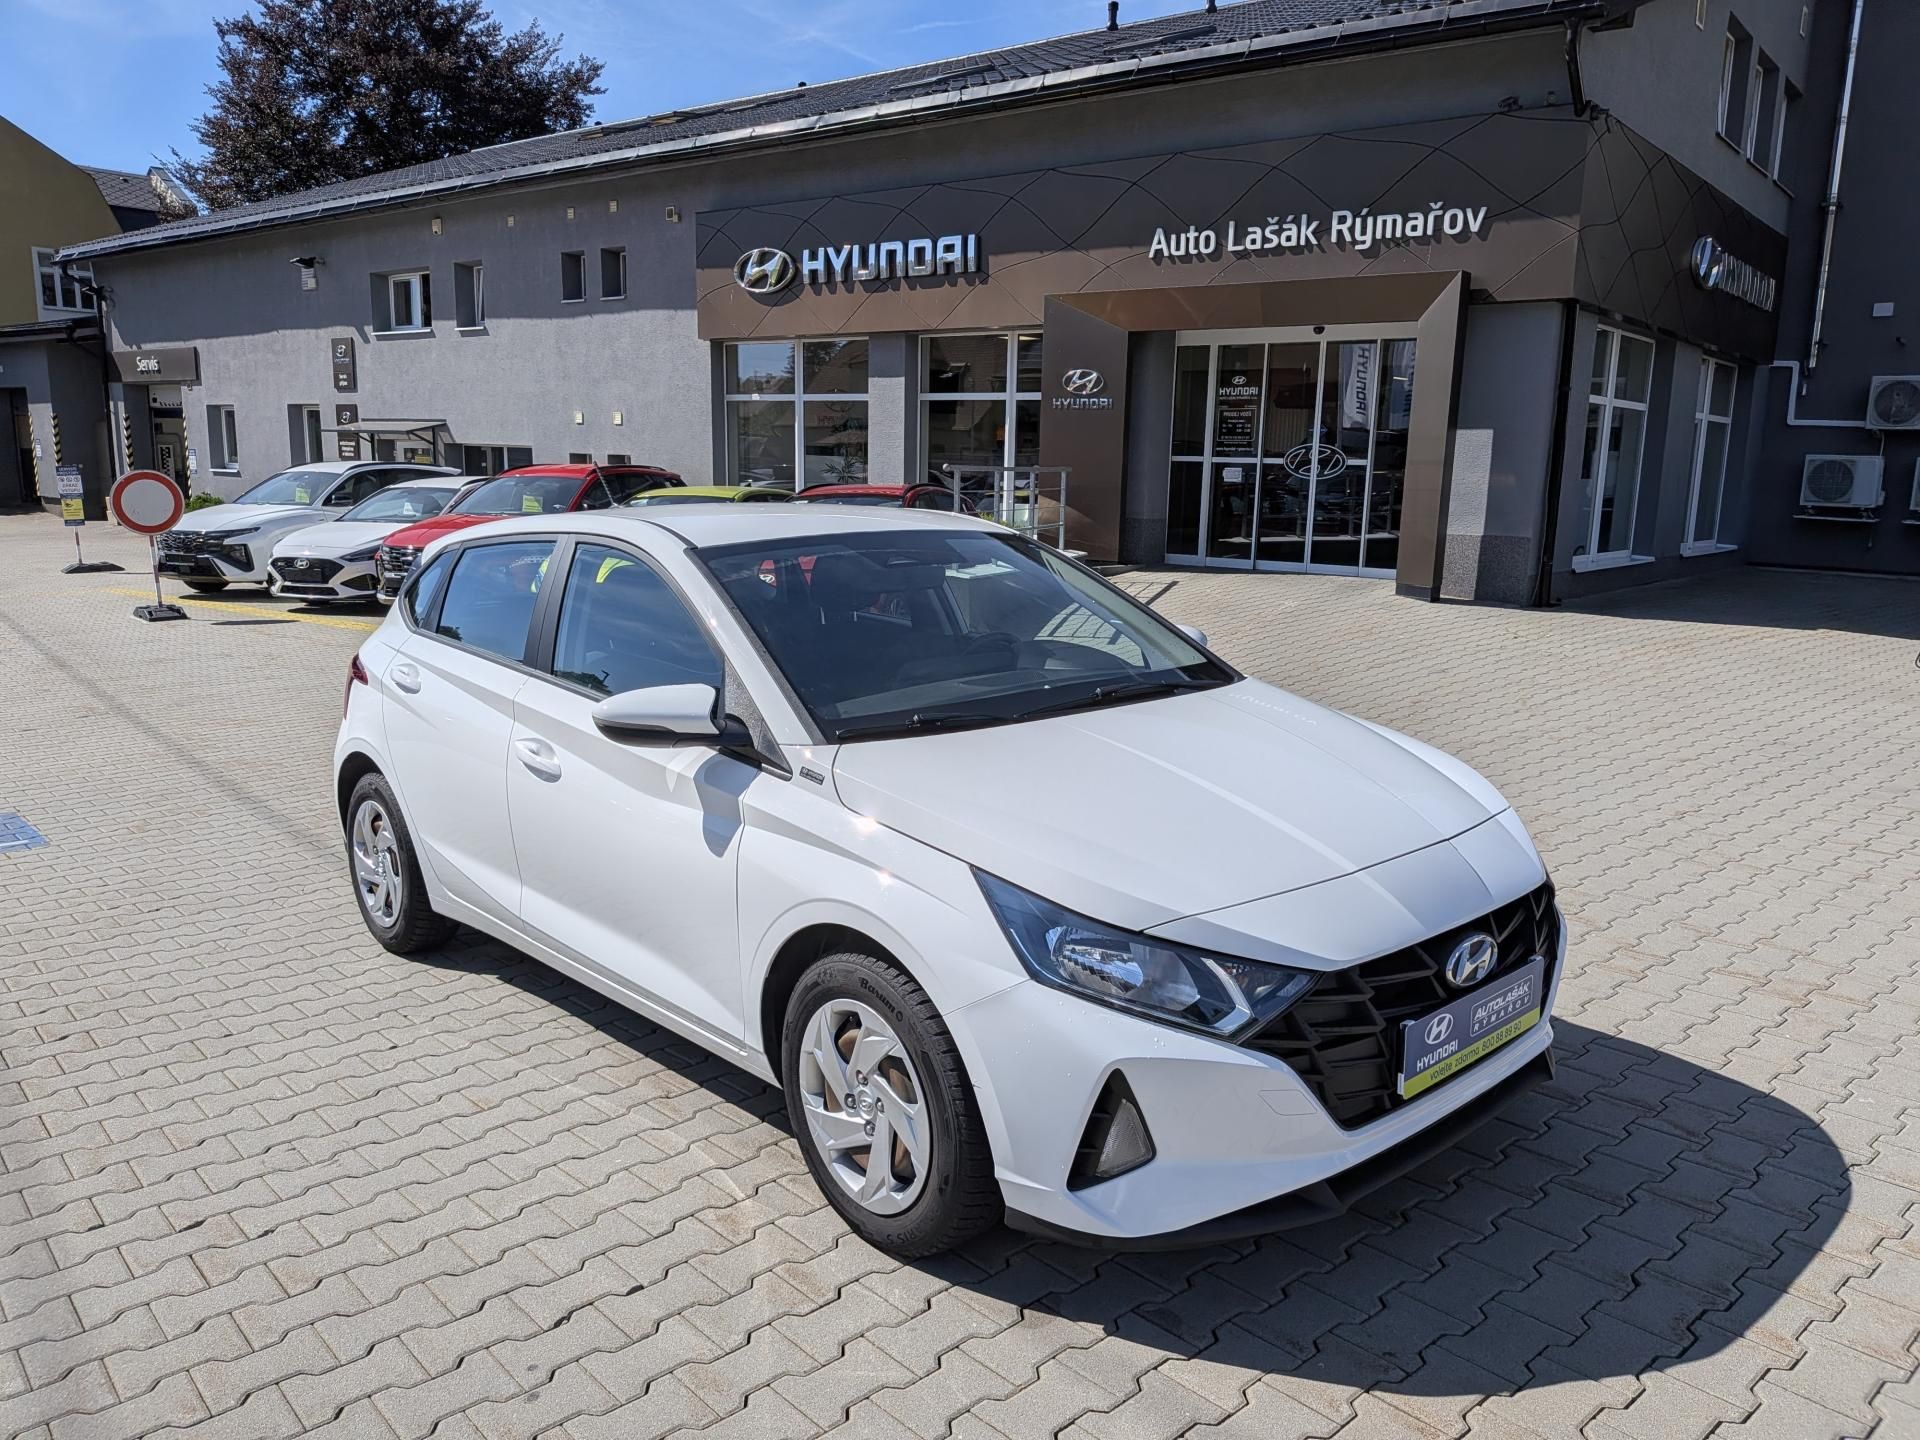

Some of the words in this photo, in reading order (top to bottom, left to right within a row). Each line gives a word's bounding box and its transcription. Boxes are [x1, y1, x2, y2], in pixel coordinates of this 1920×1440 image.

[1149, 225, 1217, 258] Auto
[1227, 213, 1320, 251] Lašák
[1331, 201, 1488, 250] Rýmařov
[802, 233, 981, 285] HYUNDAI
[136, 355, 160, 372] Servis
[1356, 345, 1371, 417] HYUNDAI
[1052, 397, 1113, 409] HYUNDAI
[1219, 386, 1259, 396] HYUNDAI
[858, 976, 896, 1014] Barum
[1473, 981, 1530, 1021] AUTOLAŠÁK
[1416, 1039, 1458, 1072] HYUNDAI
[1429, 1061, 1453, 1081] volejte
[1455, 1046, 1480, 1067] zdarma
[1481, 1038, 1495, 1052] 800
[1495, 1031, 1504, 1044] 88
[1504, 1025, 1513, 1039] 89
[1513, 1020, 1522, 1034] 90
